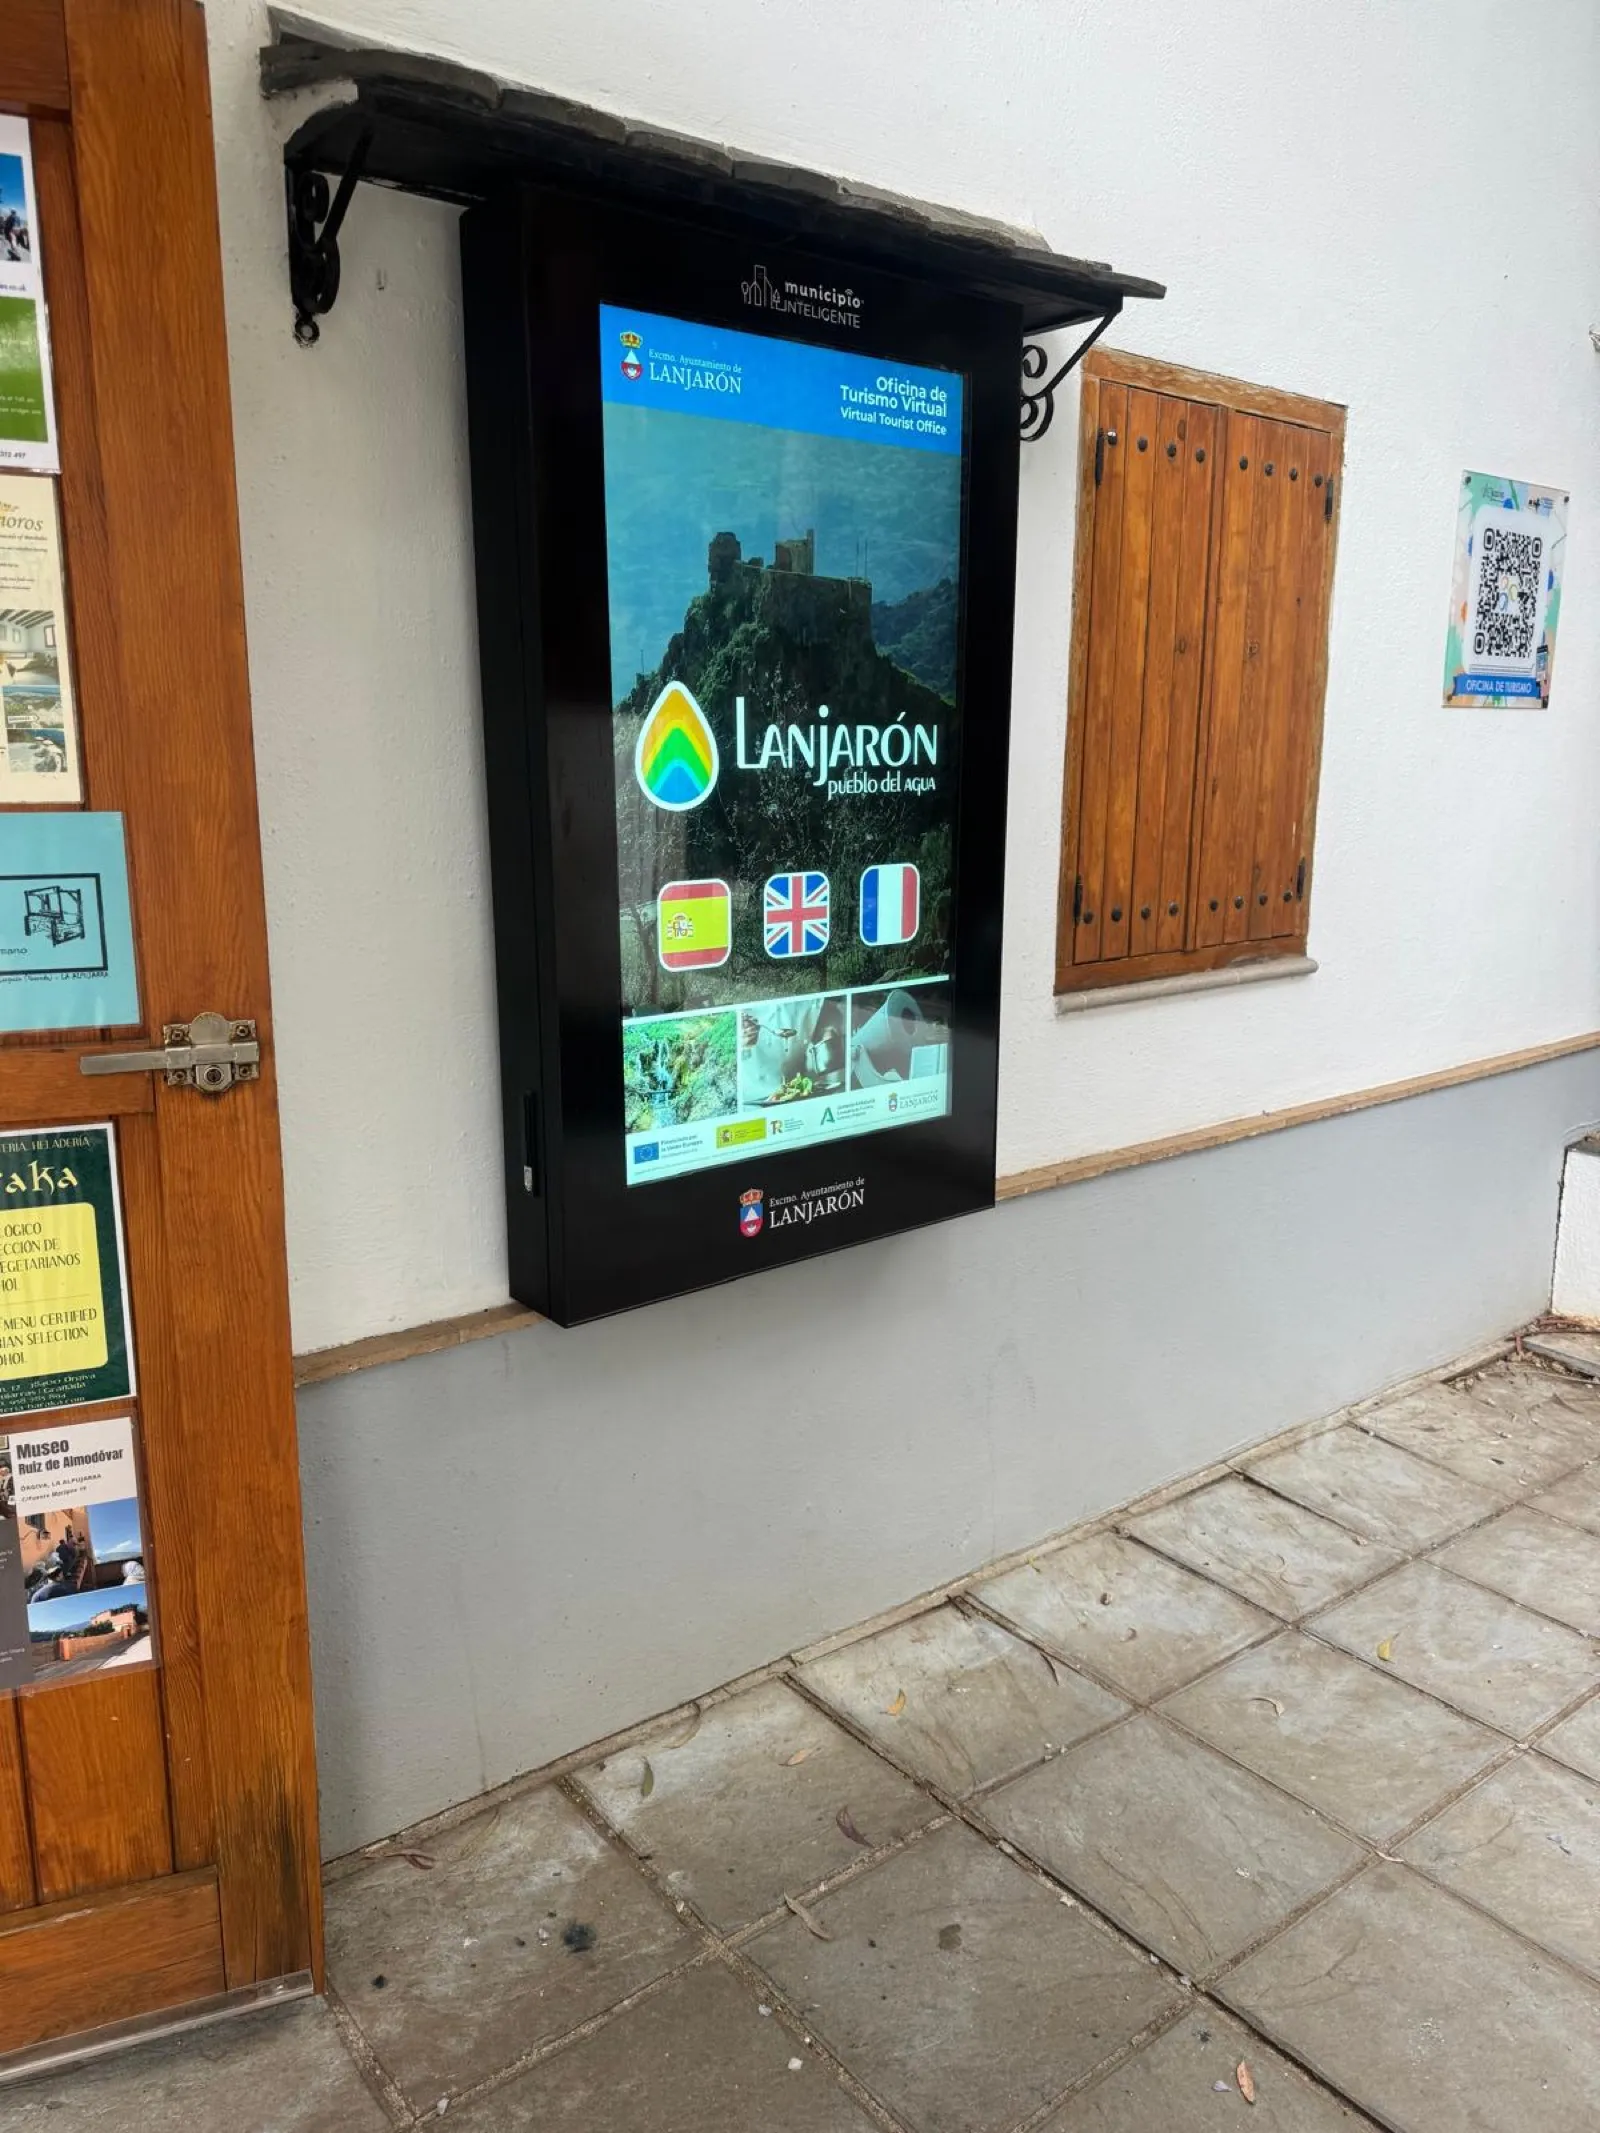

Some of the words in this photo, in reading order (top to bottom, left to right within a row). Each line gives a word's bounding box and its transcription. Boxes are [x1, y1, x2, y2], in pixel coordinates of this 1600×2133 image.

[785, 282, 861, 308] municipio
[787, 300, 861, 329] INTELIGENTE
[649, 362, 742, 394] LANJARÓN
[733, 364, 742, 373] de
[840, 385, 898, 409] Turismo
[901, 396, 947, 417] Virtual
[876, 376, 927, 399] Oficina
[930, 386, 947, 402] de
[841, 406, 877, 424] Virtual
[879, 412, 914, 430] Tourist
[916, 419, 947, 435] Office
[1466, 680, 1493, 692] OFICINA
[1495, 680, 1504, 692] DE
[0, 1160, 78, 1195] aka
[800, 1180, 854, 1201] Ayuntamiento
[855, 1176, 865, 1186] de
[769, 1188, 865, 1229] LANJARÓN
[44, 1238, 60, 1251] DE
[0, 1253, 81, 1273] EGETARIANOS
[4, 1316, 37, 1330] MENU
[41, 1307, 97, 1326] CERTIFIED
[27, 1327, 89, 1346] SELECTION
[16, 1440, 69, 1460] Museo
[18, 1460, 43, 1475] Ruiz
[45, 1459, 60, 1471] de
[63, 1449, 124, 1469] Almodóvar
